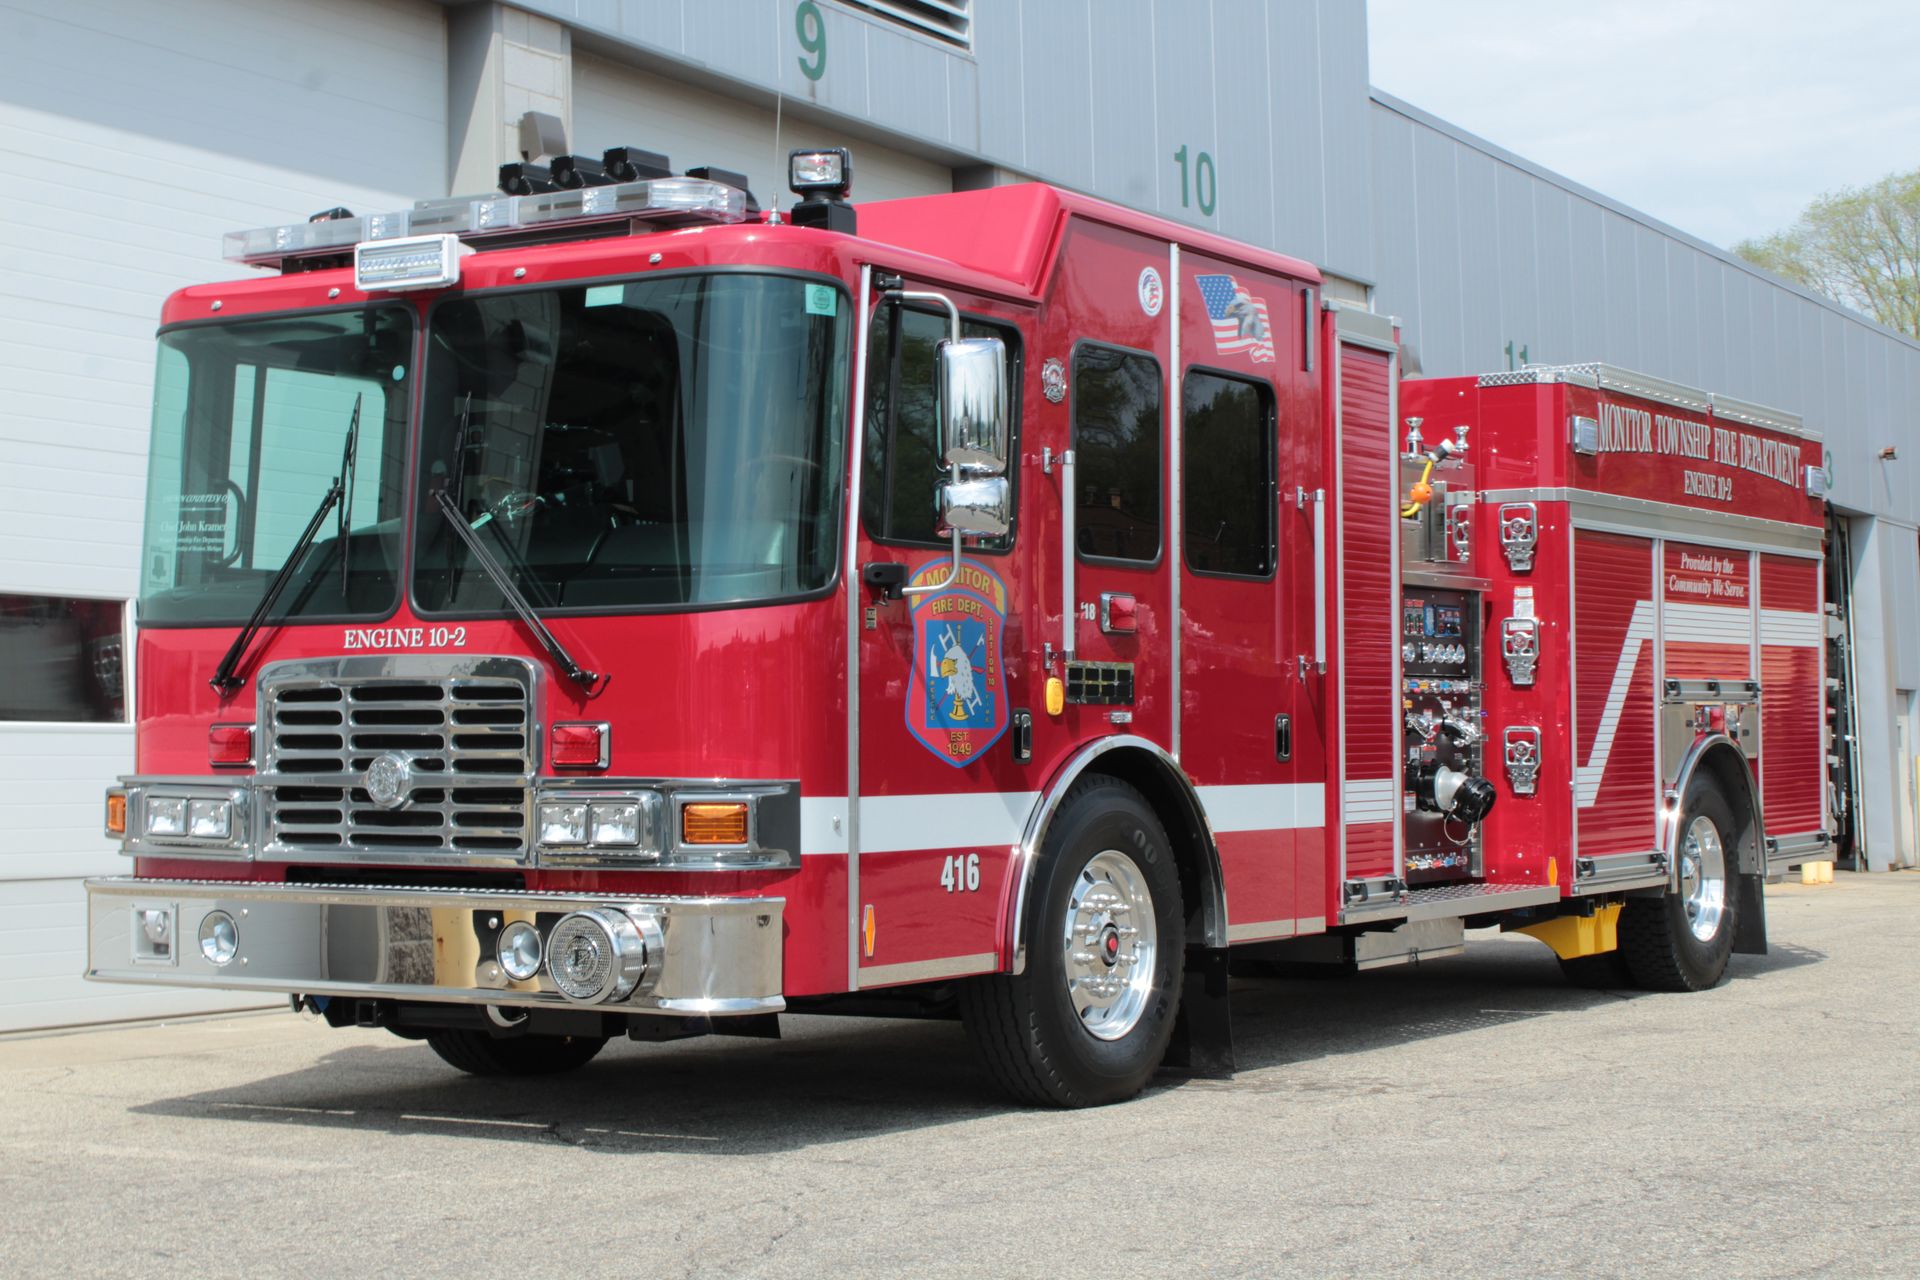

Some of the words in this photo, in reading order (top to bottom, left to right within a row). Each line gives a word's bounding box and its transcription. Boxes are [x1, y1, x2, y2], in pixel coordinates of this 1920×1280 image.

[795, 0, 827, 82] 9
[1174, 144, 1217, 217] 10
[1597, 401, 1653, 453] MONITOR
[1655, 414, 1711, 461] TOWNSHIP
[1713, 427, 1738, 467] FIRE
[1739, 432, 1801, 489] DEPARTMENT
[1684, 469, 1717, 500] ENGINE
[1717, 476, 1733, 502] 10-2
[185, 493, 222, 504] COURTESY
[178, 520, 197, 533] John
[198, 520, 228, 532] Kramer
[1680, 552, 1713, 572] Provided
[1713, 556, 1722, 576] by
[1722, 558, 1734, 574] the
[1669, 574, 1712, 598] Community
[1713, 579, 1724, 596] We
[931, 598, 954, 616] FIRE
[957, 598, 984, 619] DEPT.
[343, 628, 425, 649] ENGINE
[428, 626, 467, 648] 10-2
[988, 677, 995, 687] 10
[950, 731, 970, 742] EST.
[947, 743, 972, 756] 1949
[940, 853, 980, 893] 416
